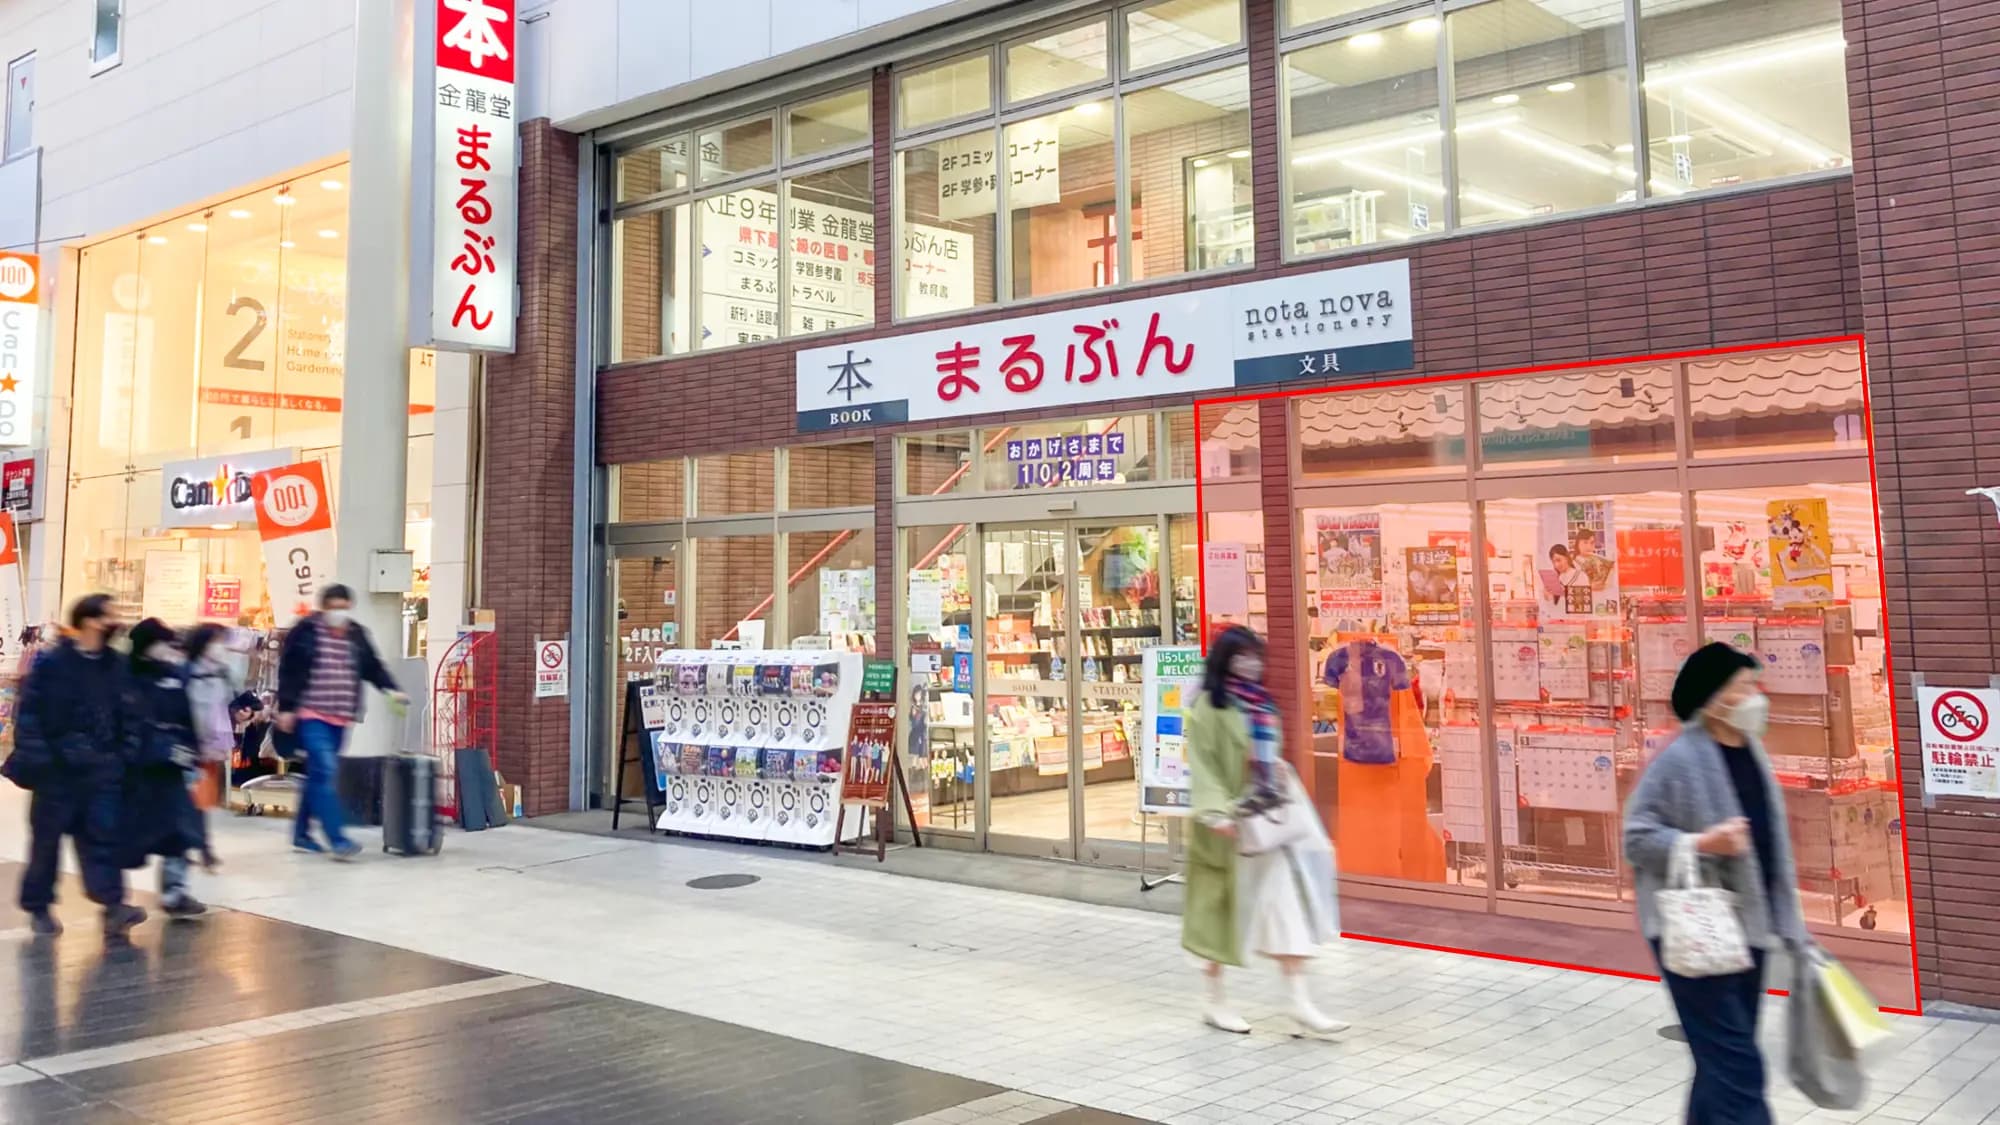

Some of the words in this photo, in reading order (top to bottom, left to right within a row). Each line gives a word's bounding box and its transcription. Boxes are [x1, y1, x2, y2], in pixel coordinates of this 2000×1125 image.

[442, 0, 509, 69] 本
[438, 83, 511, 119] 金龍堂
[942, 156, 958, 171] 2F
[942, 183, 958, 198] 2F
[450, 124, 496, 331] まるぶん
[822, 213, 874, 244] 金龍堂
[1245, 299, 1309, 327] nota
[1319, 289, 1393, 317] nova
[223, 296, 267, 372] 2
[1248, 313, 1393, 342] stationery
[935, 311, 1196, 402] まるぶん
[1299, 352, 1341, 375] 文具
[826, 350, 873, 402] 本
[829, 408, 873, 425] BOOK
[1009, 436, 1122, 459] おかげさまで
[1021, 461, 1113, 484] 102周年
[1931, 750, 1996, 768] 駐輪禁止
